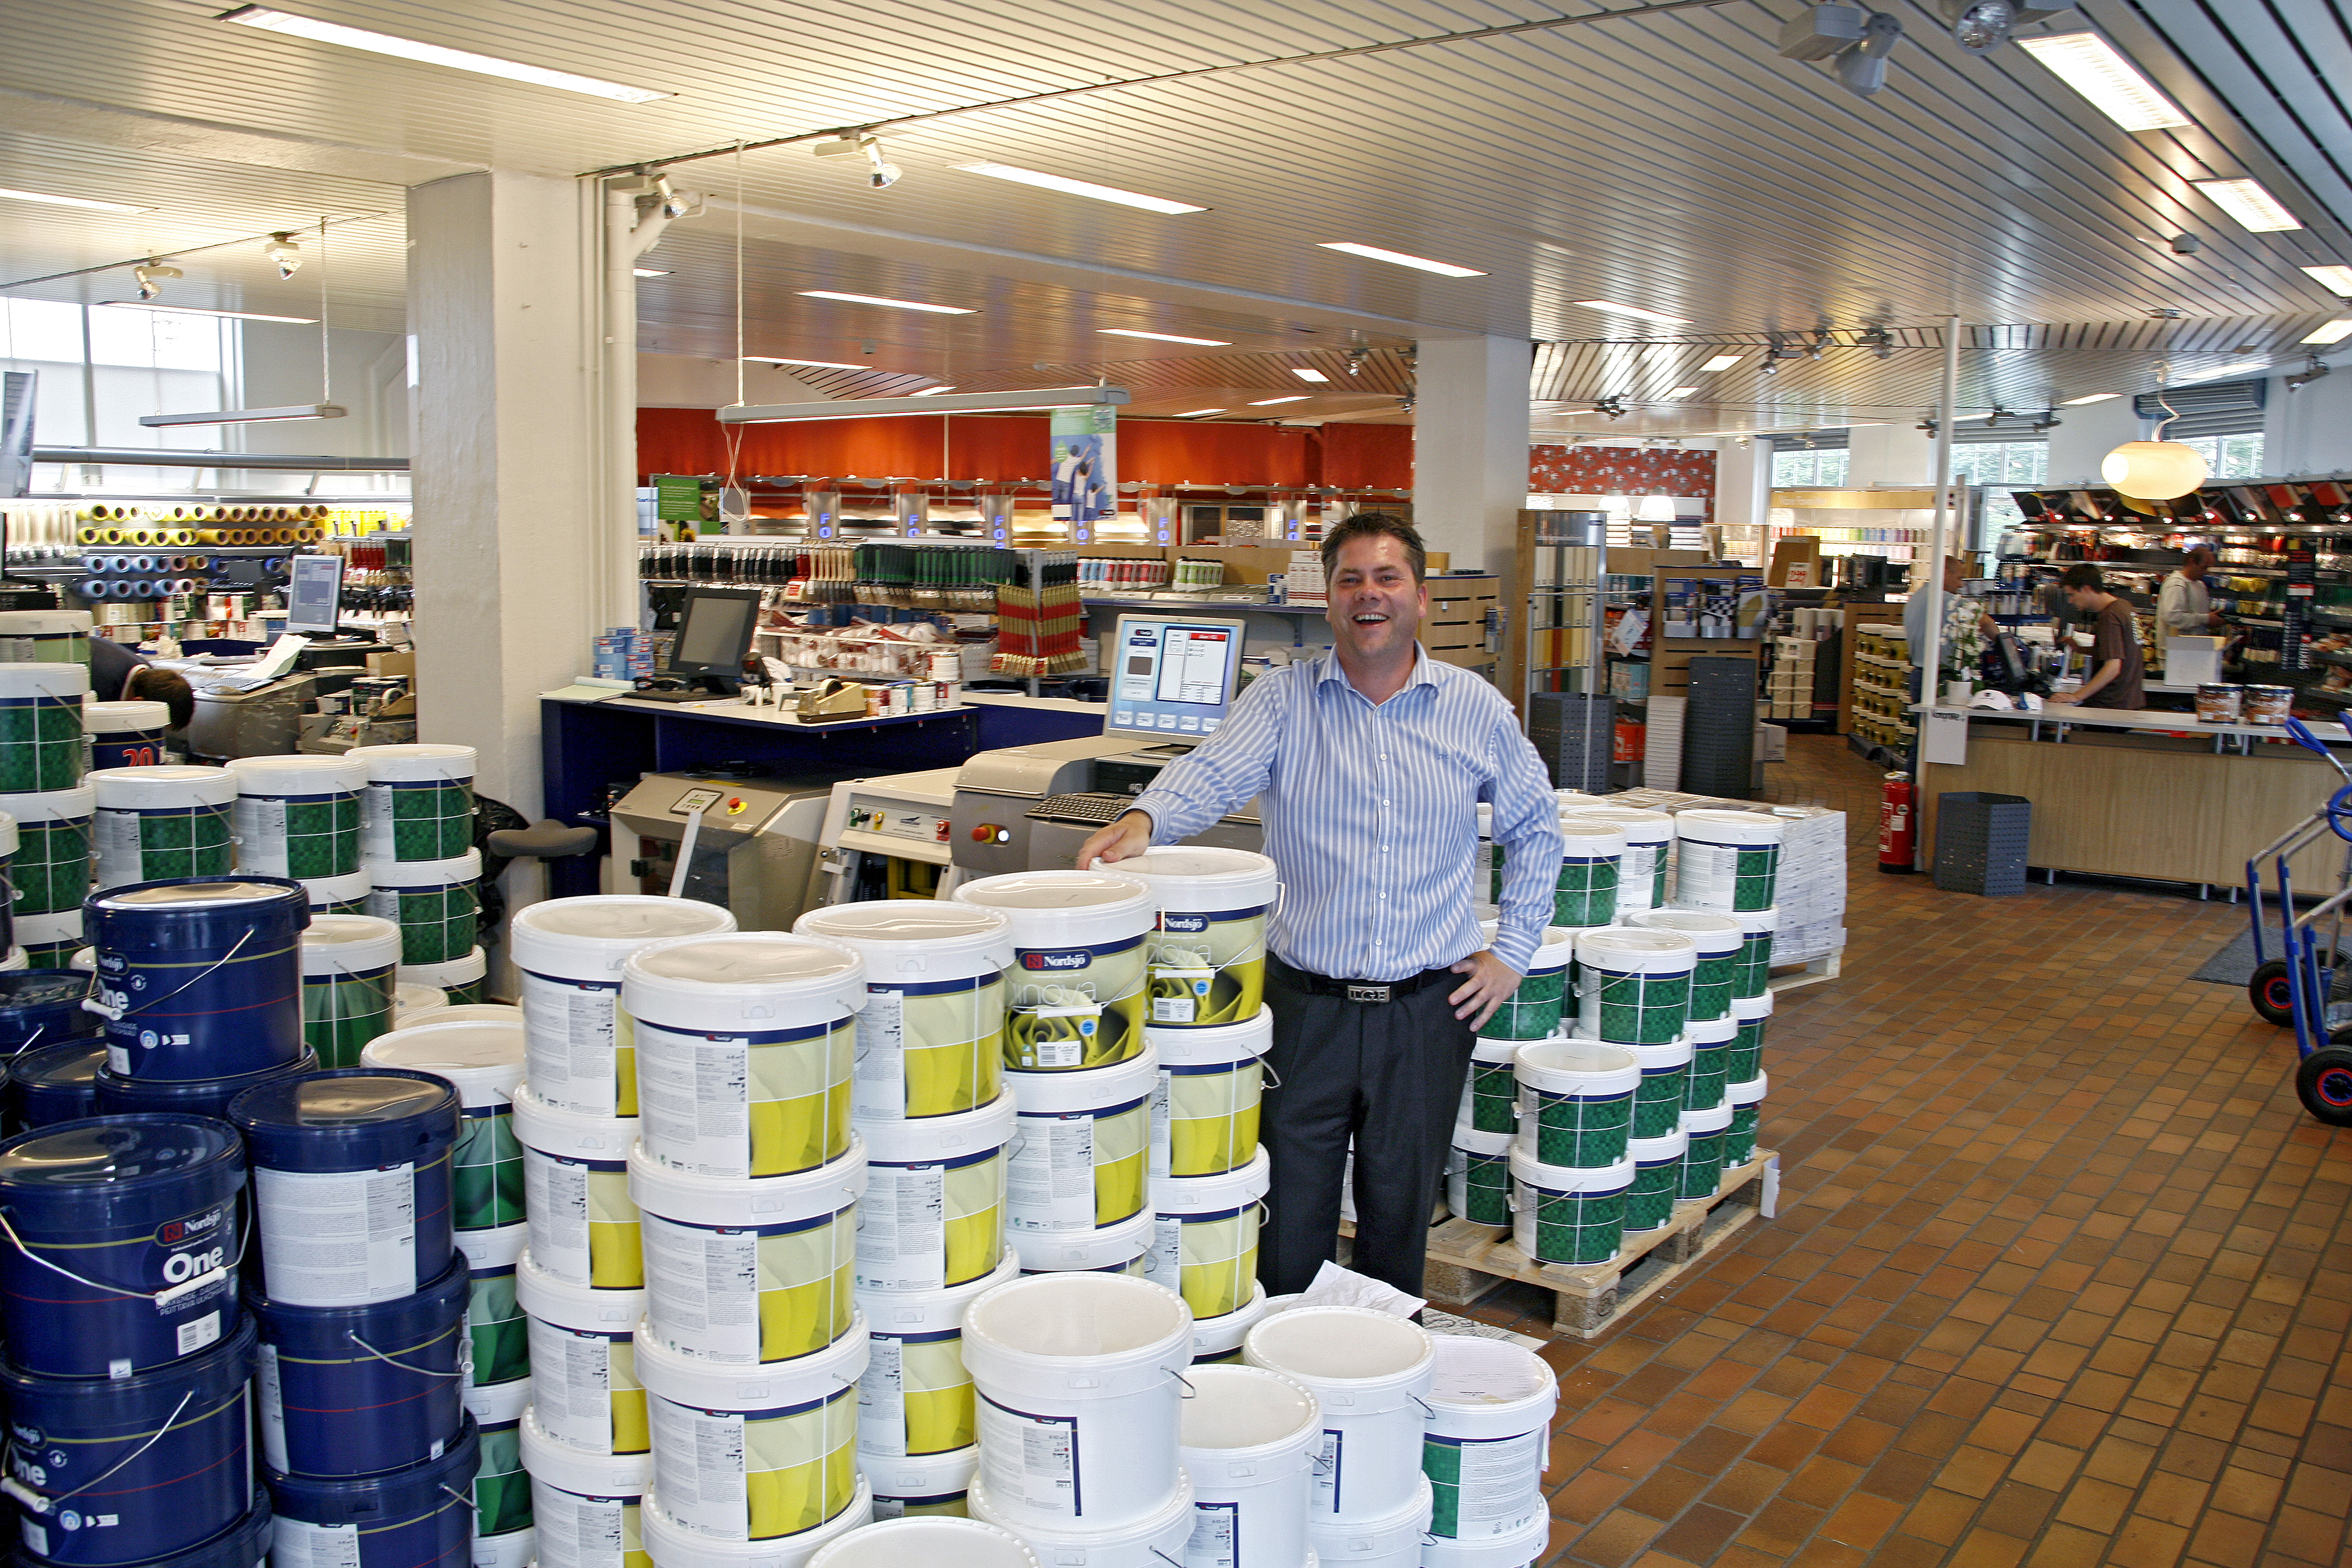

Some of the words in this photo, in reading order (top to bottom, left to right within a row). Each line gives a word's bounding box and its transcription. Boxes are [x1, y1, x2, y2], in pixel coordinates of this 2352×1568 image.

[1165, 918, 1203, 931] Nordsjö
[1044, 954, 1086, 968] Nordsjö
[1146, 943, 1212, 964] nova
[184, 1208, 222, 1235] Nordsjö
[163, 1245, 225, 1284] One
